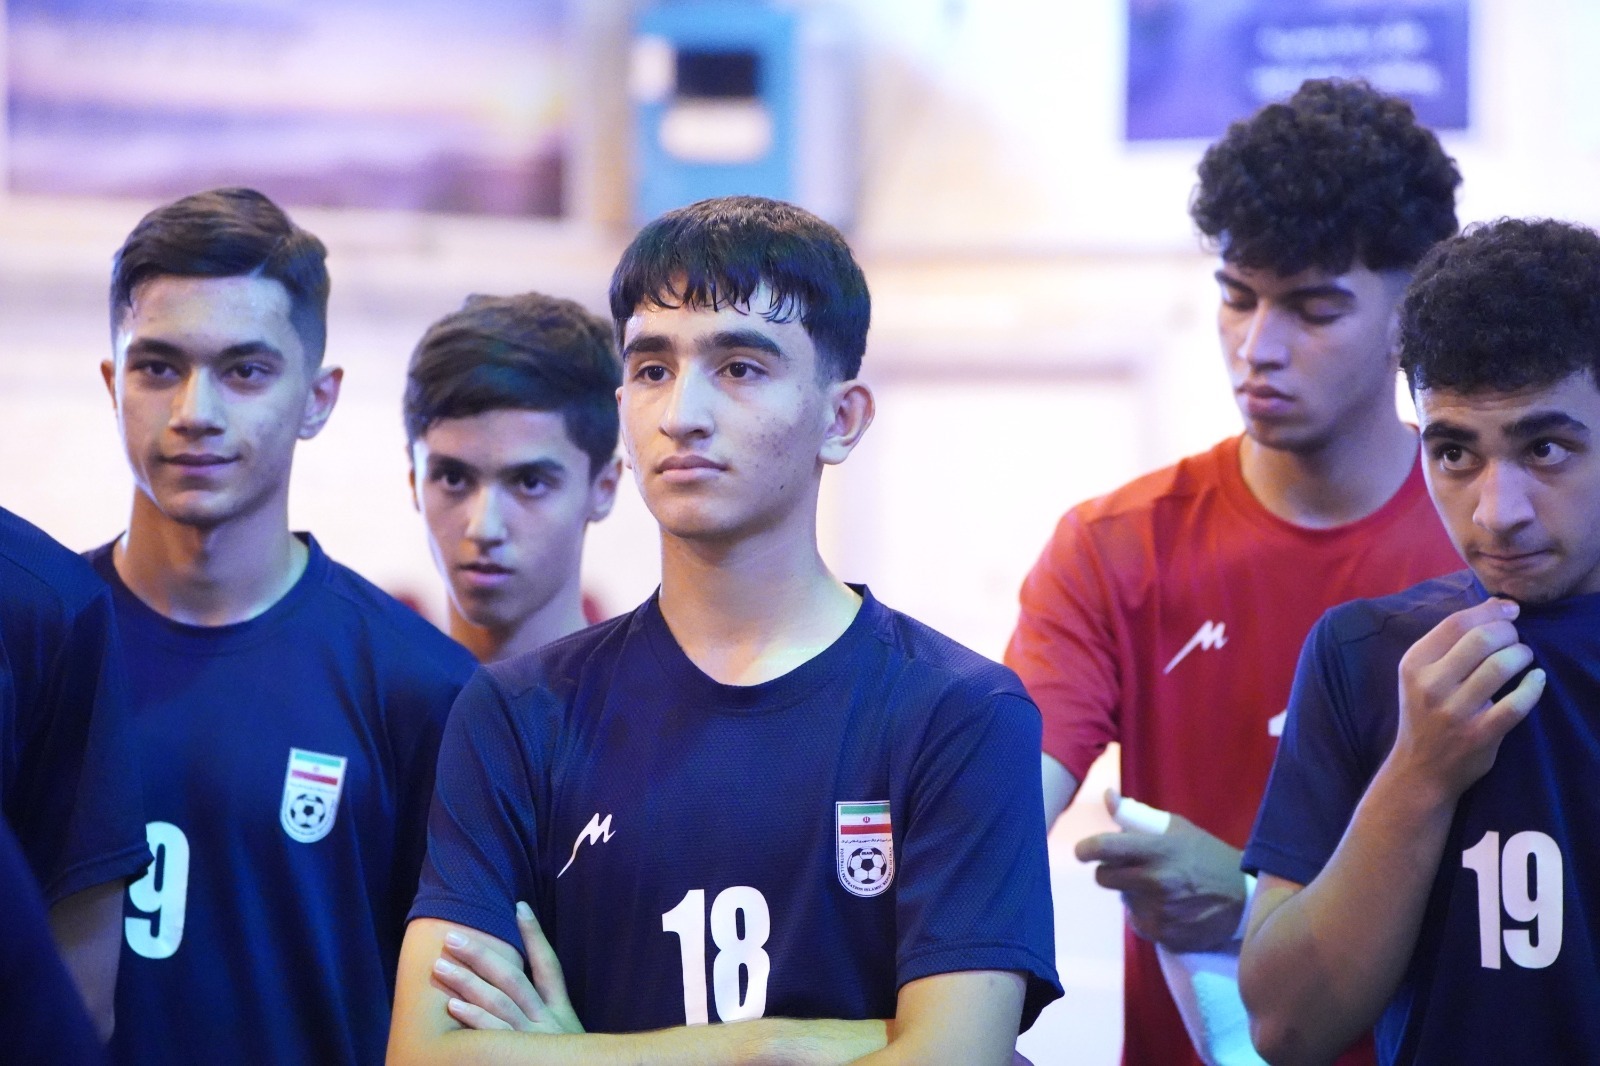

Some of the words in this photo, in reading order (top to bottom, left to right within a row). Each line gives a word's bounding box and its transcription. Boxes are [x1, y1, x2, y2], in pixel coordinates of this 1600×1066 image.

[841, 872, 864, 892] FEDERATION
[1462, 830, 1564, 970] 19
[661, 885, 771, 1027] 18
